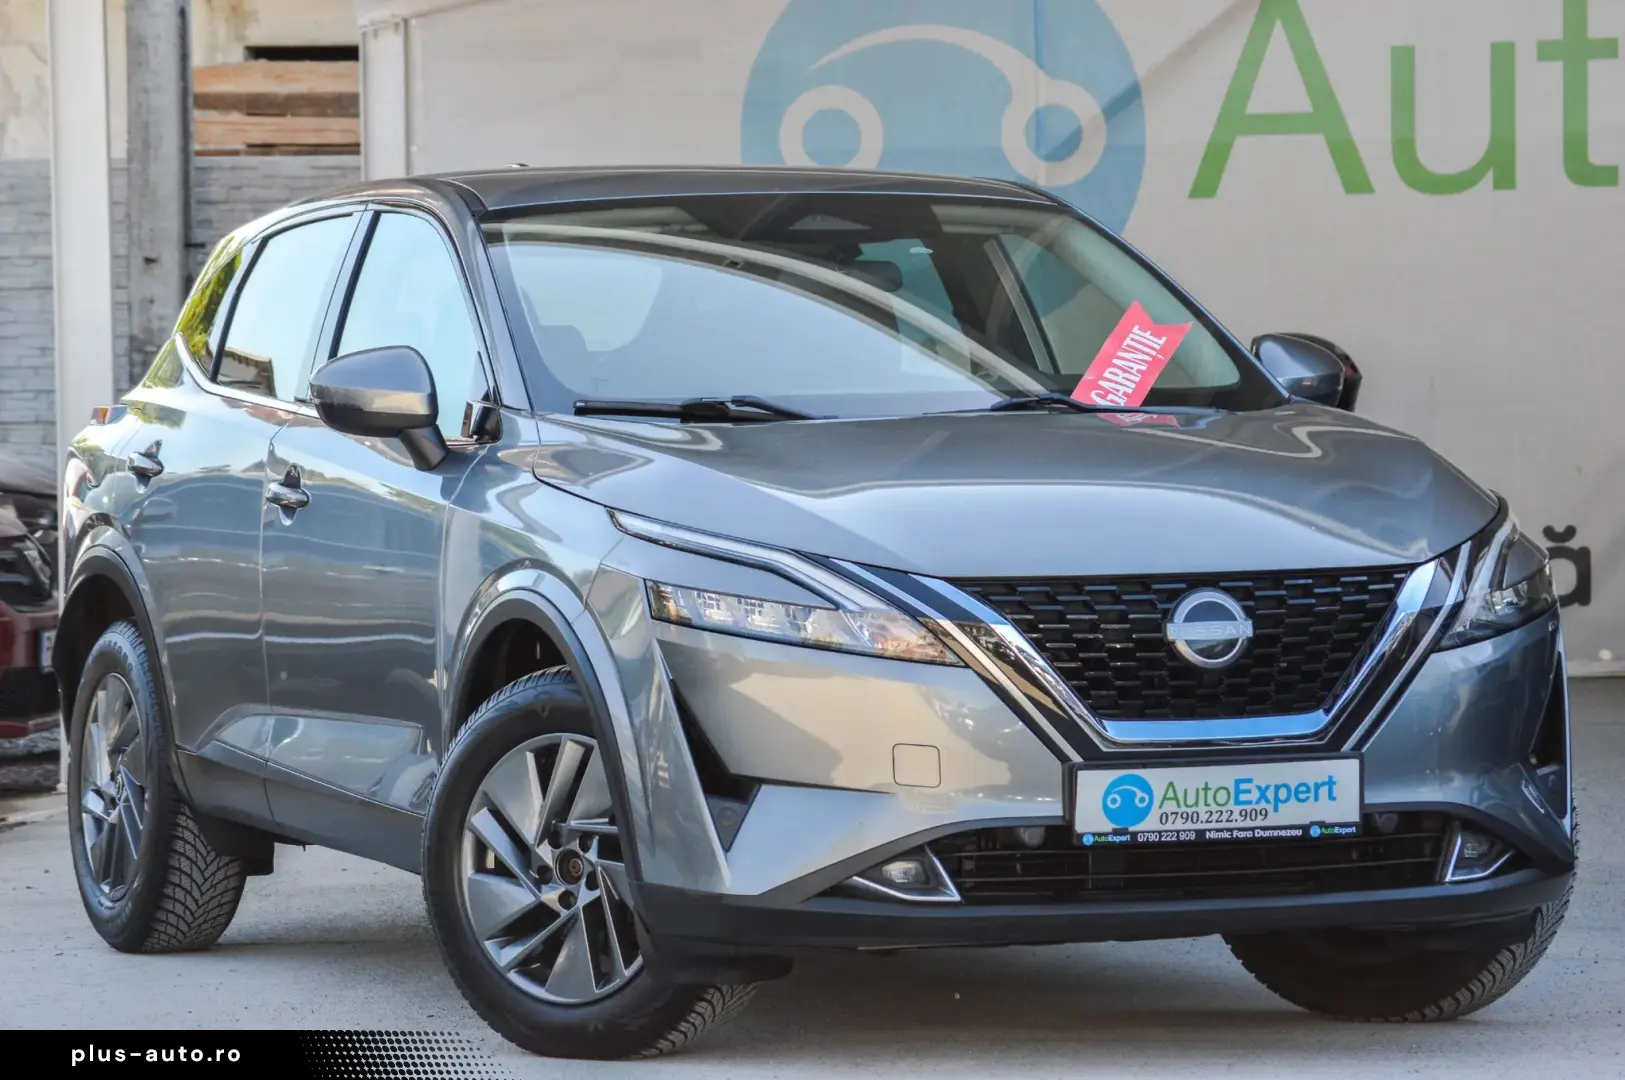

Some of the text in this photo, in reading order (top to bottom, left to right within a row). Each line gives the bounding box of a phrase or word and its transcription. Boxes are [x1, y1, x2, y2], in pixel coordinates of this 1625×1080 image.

[1188, 0, 1620, 200] Aut
[1158, 774, 1337, 813] AutoExpert
[1159, 807, 1269, 826] 0790.222.909
[1094, 825, 1357, 843] AutoExpert 0790 222 909 Nimic Fara Dumnezeu AutoExpert
